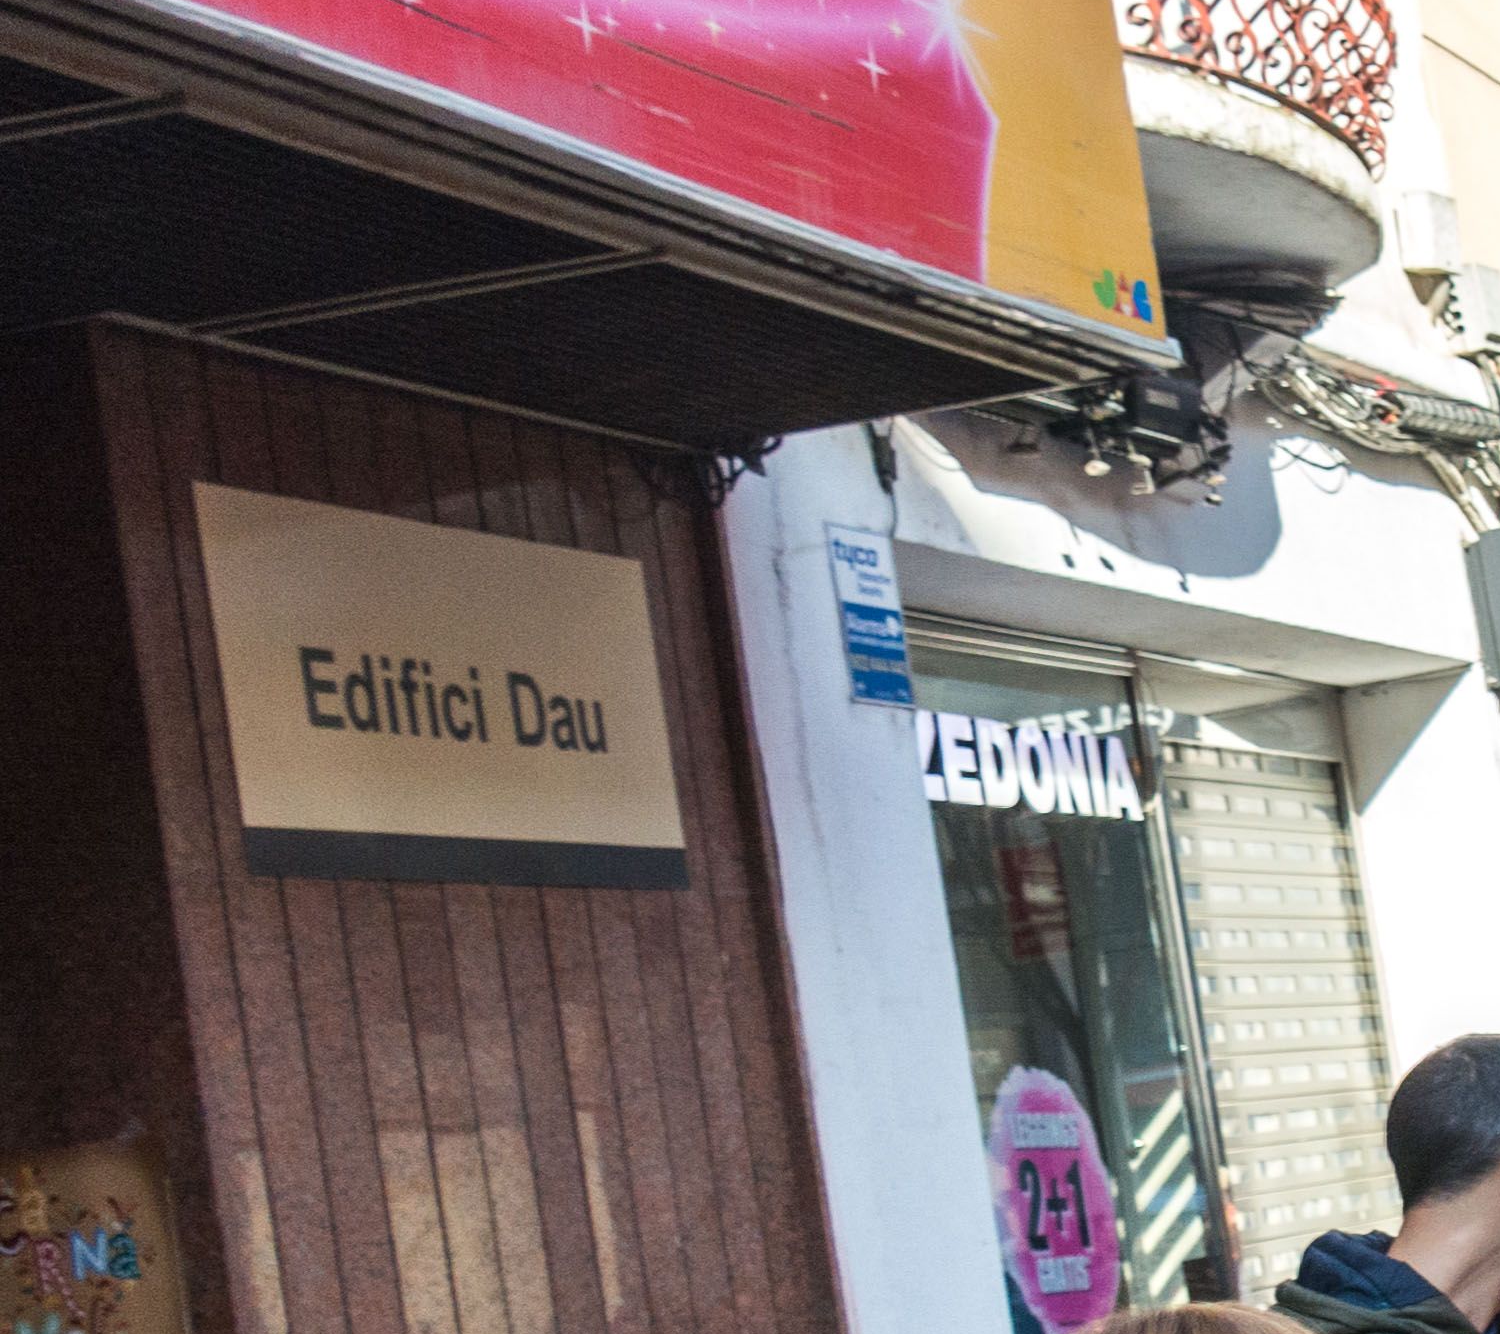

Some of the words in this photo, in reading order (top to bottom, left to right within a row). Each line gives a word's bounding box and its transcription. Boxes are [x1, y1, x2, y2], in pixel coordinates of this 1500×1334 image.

[833, 536, 878, 570] tyco
[299, 645, 488, 744] Edifici
[506, 670, 608, 754] Dau
